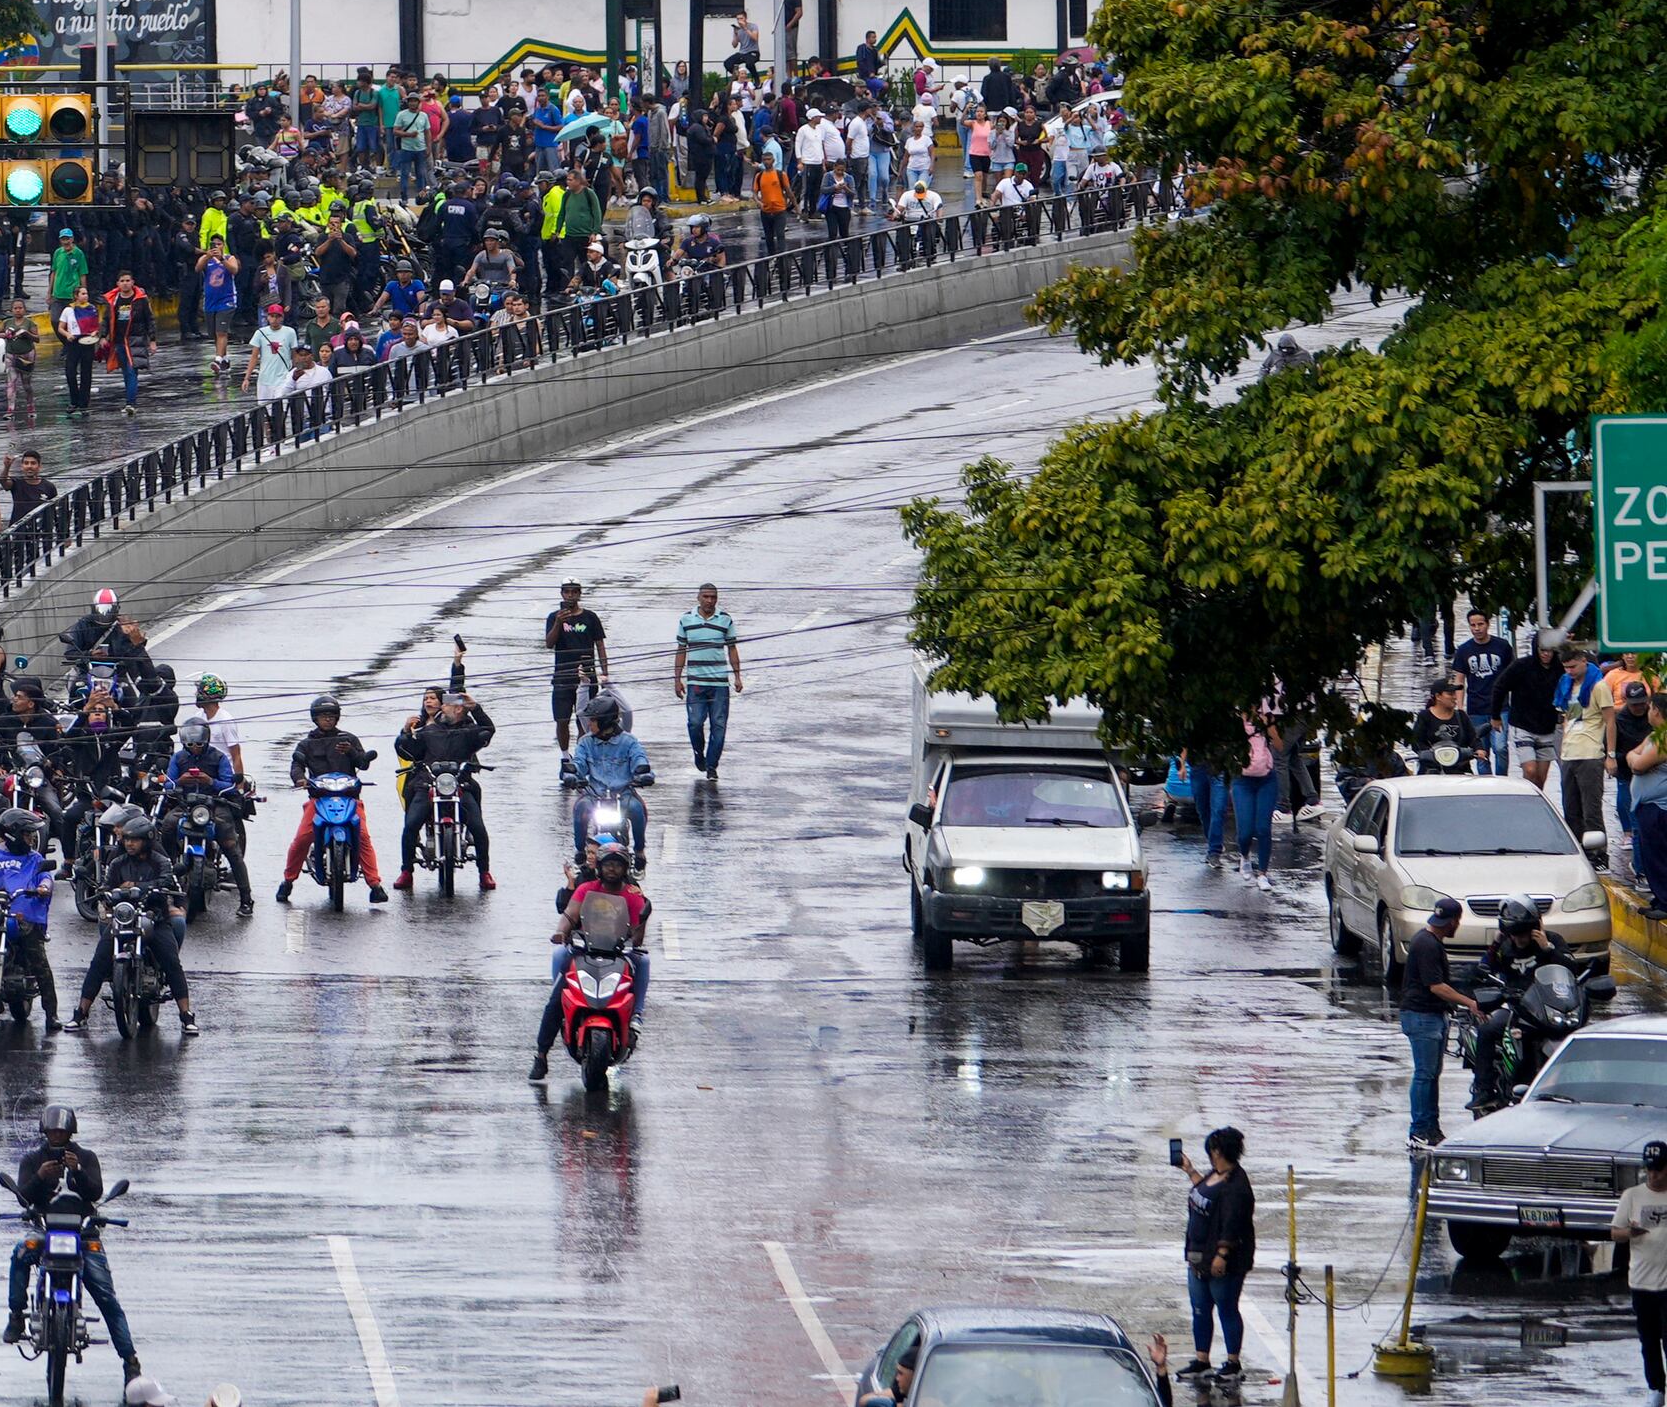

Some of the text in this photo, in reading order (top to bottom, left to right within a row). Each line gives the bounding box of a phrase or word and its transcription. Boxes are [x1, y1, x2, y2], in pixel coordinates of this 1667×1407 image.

[55, 17, 67, 34] a
[137, 4, 189, 39] pueblo
[1613, 485, 1667, 526] ZO
[1613, 541, 1667, 581] PE
